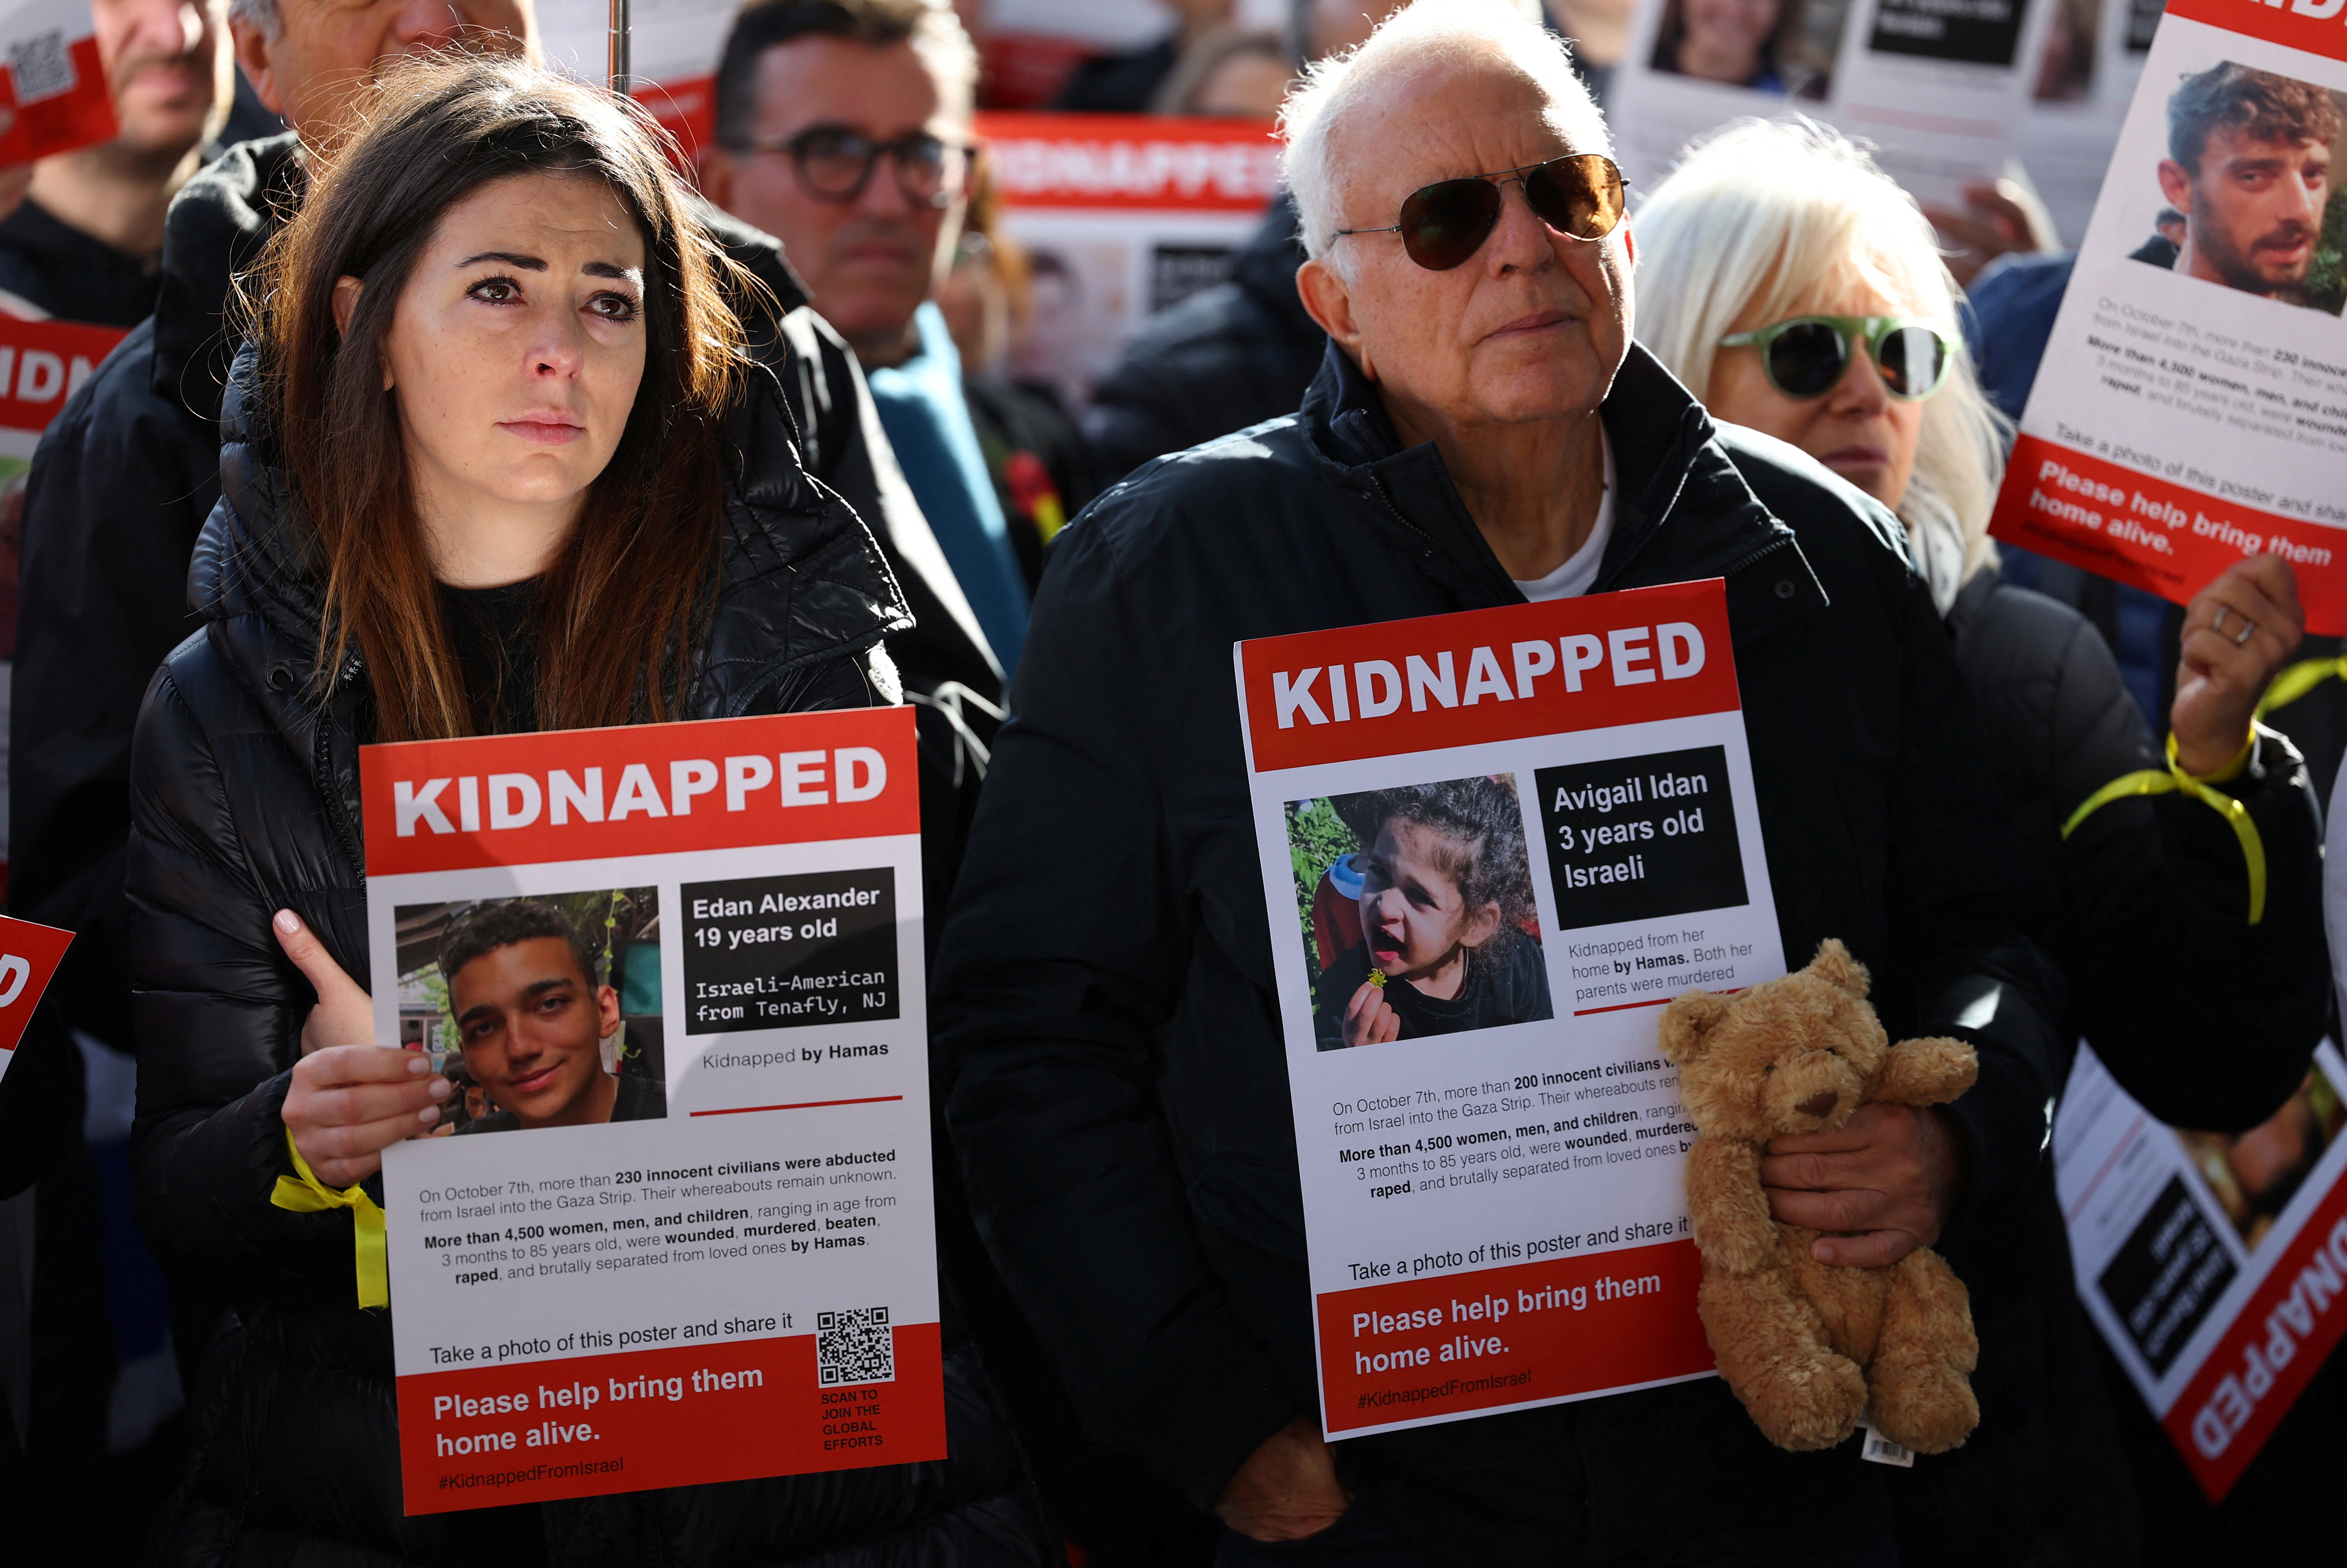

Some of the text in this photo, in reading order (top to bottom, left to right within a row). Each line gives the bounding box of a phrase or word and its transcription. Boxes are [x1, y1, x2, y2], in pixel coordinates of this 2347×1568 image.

[2031, 490, 2102, 528] home
[2107, 519, 2172, 554] alive.
[2040, 460, 2124, 506] Please
[2130, 491, 2187, 529] help
[2192, 512, 2262, 556] bring
[1272, 621, 1706, 729] KIDNAPPED
[393, 746, 887, 837] KIDNAPPED
[1554, 772, 1708, 812] Avigail Idan
[1558, 807, 1704, 854] 3 years old
[1564, 854, 1645, 888] Israeli
[693, 887, 880, 919] Edan Alexander
[694, 917, 837, 949] 19 years old
[1568, 930, 1704, 959] Kidnapped from her
[1571, 944, 1752, 979] home by Hamas. Both her
[696, 970, 884, 998] Israeli-American
[1576, 965, 1734, 1003] parents were murdered
[696, 991, 885, 1022] from Tenafly, NJ
[703, 1044, 888, 1068] Kidnapped by Hamas
[1332, 1102, 1353, 1116] On
[1356, 1095, 1411, 1112] October
[1415, 1089, 1440, 1104] 7th,
[1444, 1086, 1478, 1100] more
[1481, 1081, 1511, 1095] than
[1513, 1074, 1538, 1090] 200
[1541, 1065, 1603, 1086] innocent
[1605, 1059, 1661, 1077] civilians
[1339, 1110, 1642, 1163] More than 4,500 women, men, and children,
[419, 1148, 895, 1203] On October 7th, more than 230 innocent civilians were abducted
[420, 1170, 896, 1222] from Israel into the Gaza Strip. Their whereabouts remain unknown.
[424, 1195, 896, 1249] More than 4,500 women, men, and children, ranging in age from
[442, 1215, 880, 1266] 3 months to 85 years old, were wounded, murdered, beaten,
[455, 1236, 869, 1286] raped, and brutally separated from loved ones by Hamas.
[1347, 1216, 1687, 1280] Take a photo of this poster and share it
[1353, 1275, 1660, 1337] Please help bring them
[429, 1312, 793, 1363] Take a photo of this poster and share it
[1355, 1335, 1509, 1375] home alive.
[434, 1368, 763, 1420] Please help bring them
[820, 1389, 878, 1404] SCAN TO
[1357, 1369, 1531, 1409] #KidnappedFromIsrael
[822, 1404, 880, 1420] JOIN THE
[822, 1420, 877, 1435] GLOBAL
[436, 1420, 600, 1457] home alive.
[824, 1434, 883, 1450] EFFORTS
[438, 1456, 623, 1490] #KidnappedFromIsrael
